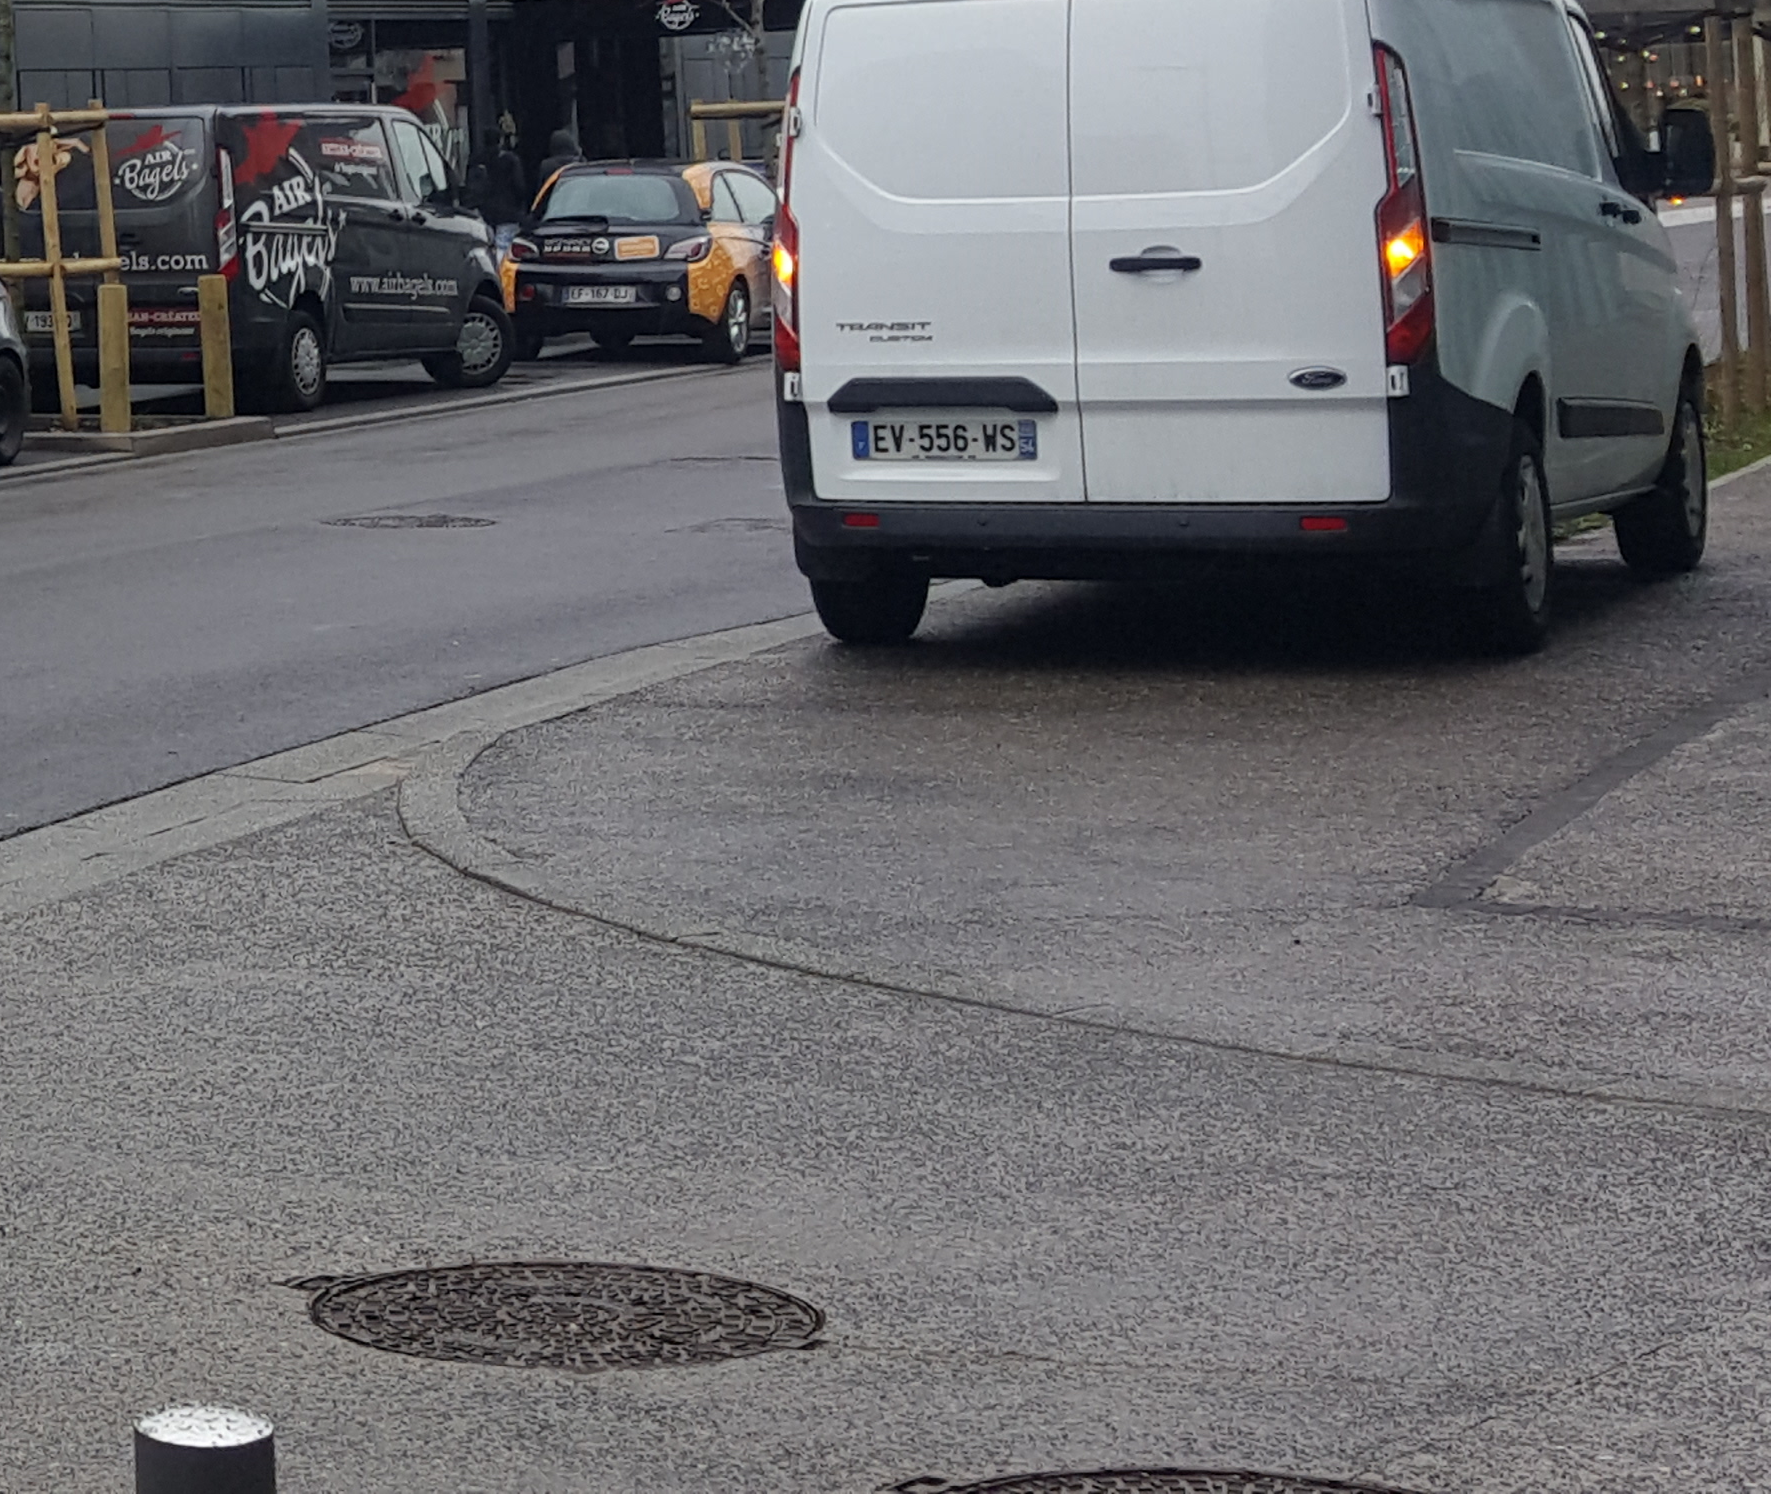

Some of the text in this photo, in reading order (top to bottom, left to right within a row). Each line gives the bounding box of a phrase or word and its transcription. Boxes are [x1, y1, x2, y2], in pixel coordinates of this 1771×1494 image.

[144, 149, 173, 165] AIR
[118, 154, 190, 200] Bagels
[272, 175, 312, 216] AIR
[350, 271, 458, 300] www.airbagels.com
[836, 321, 932, 332] TRANSIT
[872, 424, 1016, 453] EV-556-WS
